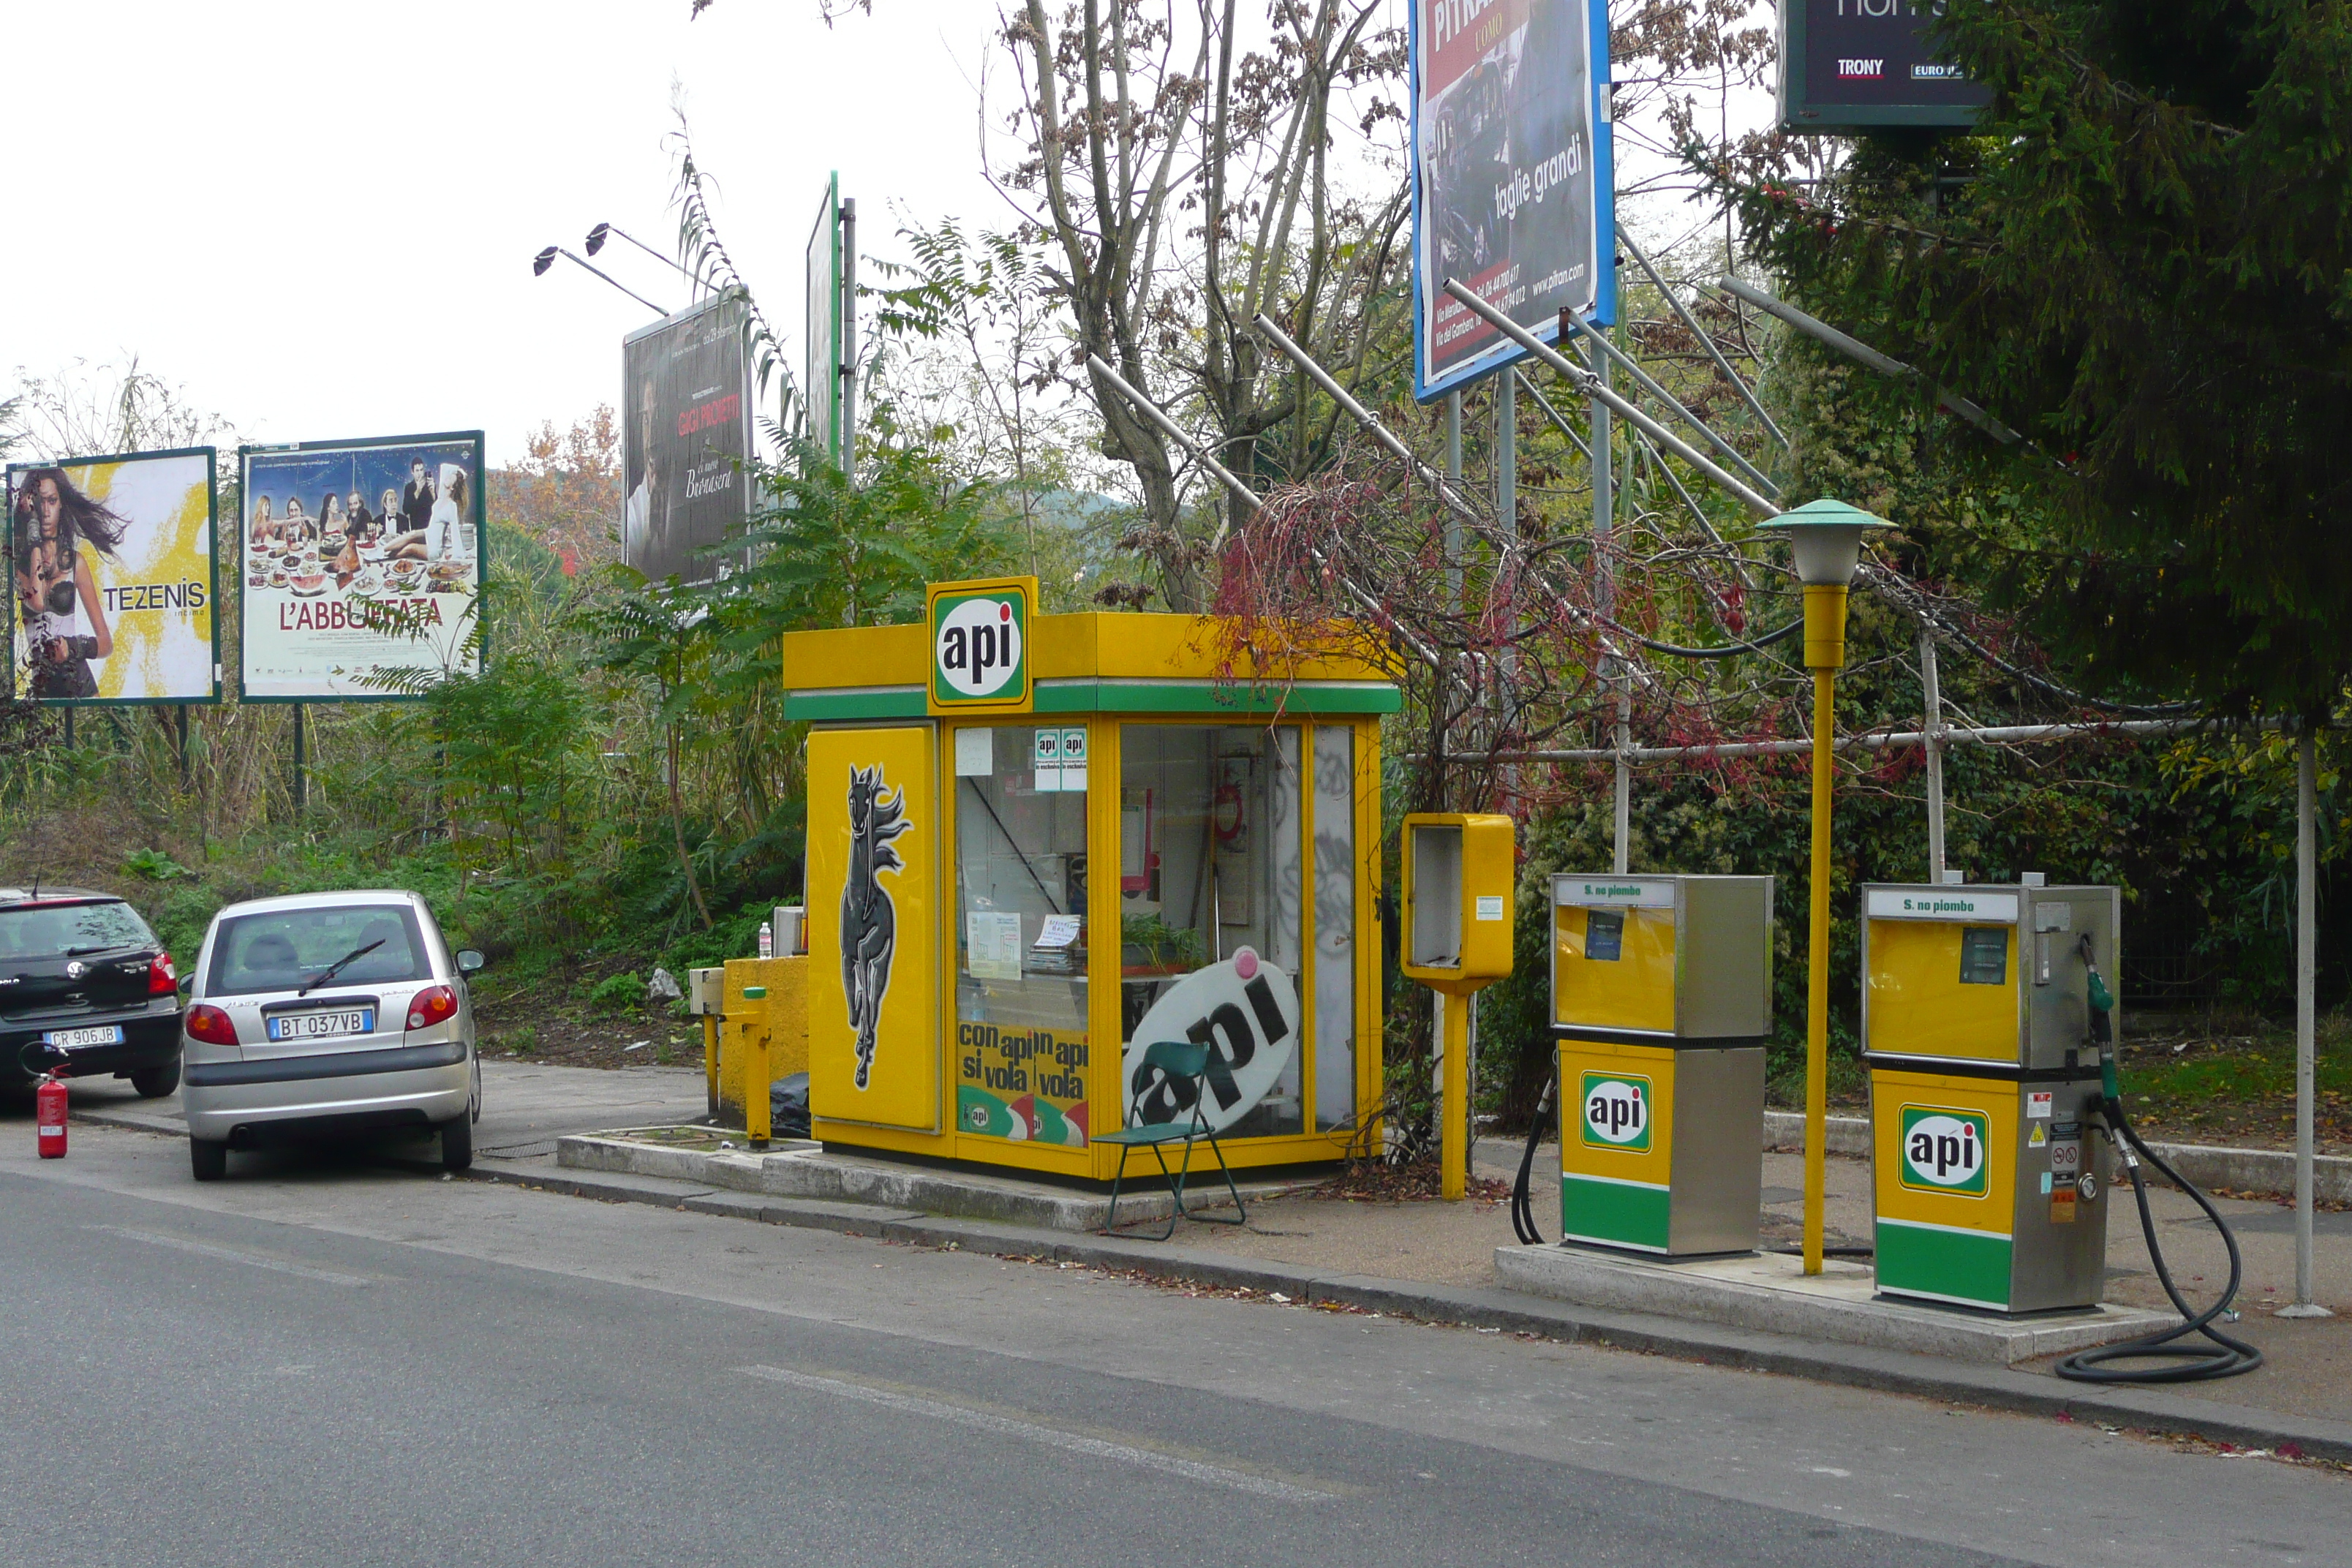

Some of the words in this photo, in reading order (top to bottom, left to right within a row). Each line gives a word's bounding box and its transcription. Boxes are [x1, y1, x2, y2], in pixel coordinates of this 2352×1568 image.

[1475, 12, 1502, 52] UOMO
[1838, 59, 1883, 75] TRONY
[1495, 167, 1530, 220] taglie
[1535, 132, 1581, 203] grandi
[1444, 325, 1452, 344] del
[678, 407, 698, 437] GIGI
[103, 578, 205, 611] TEZENIS
[943, 603, 1011, 685] api
[1039, 737, 1055, 753] api
[1066, 737, 1082, 753] api
[1608, 884, 1641, 898] piombo
[1904, 899, 1915, 911] S.
[1918, 901, 1931, 911] no
[1933, 899, 1974, 913] piombo
[53, 1033, 69, 1047] CR
[73, 1028, 115, 1044] 906JB
[281, 1019, 301, 1036] BT
[308, 1014, 361, 1034] 037VB
[1131, 950, 1289, 1124] api
[959, 1024, 998, 1048] con
[1000, 1029, 1033, 1066] api
[1055, 1035, 1088, 1074] api
[963, 1048, 982, 1079] si
[984, 1061, 1028, 1092] vola
[1039, 1068, 1084, 1099] vola
[973, 1109, 987, 1124] api
[1590, 1088, 1640, 1136] api
[1910, 1124, 1974, 1177] api
